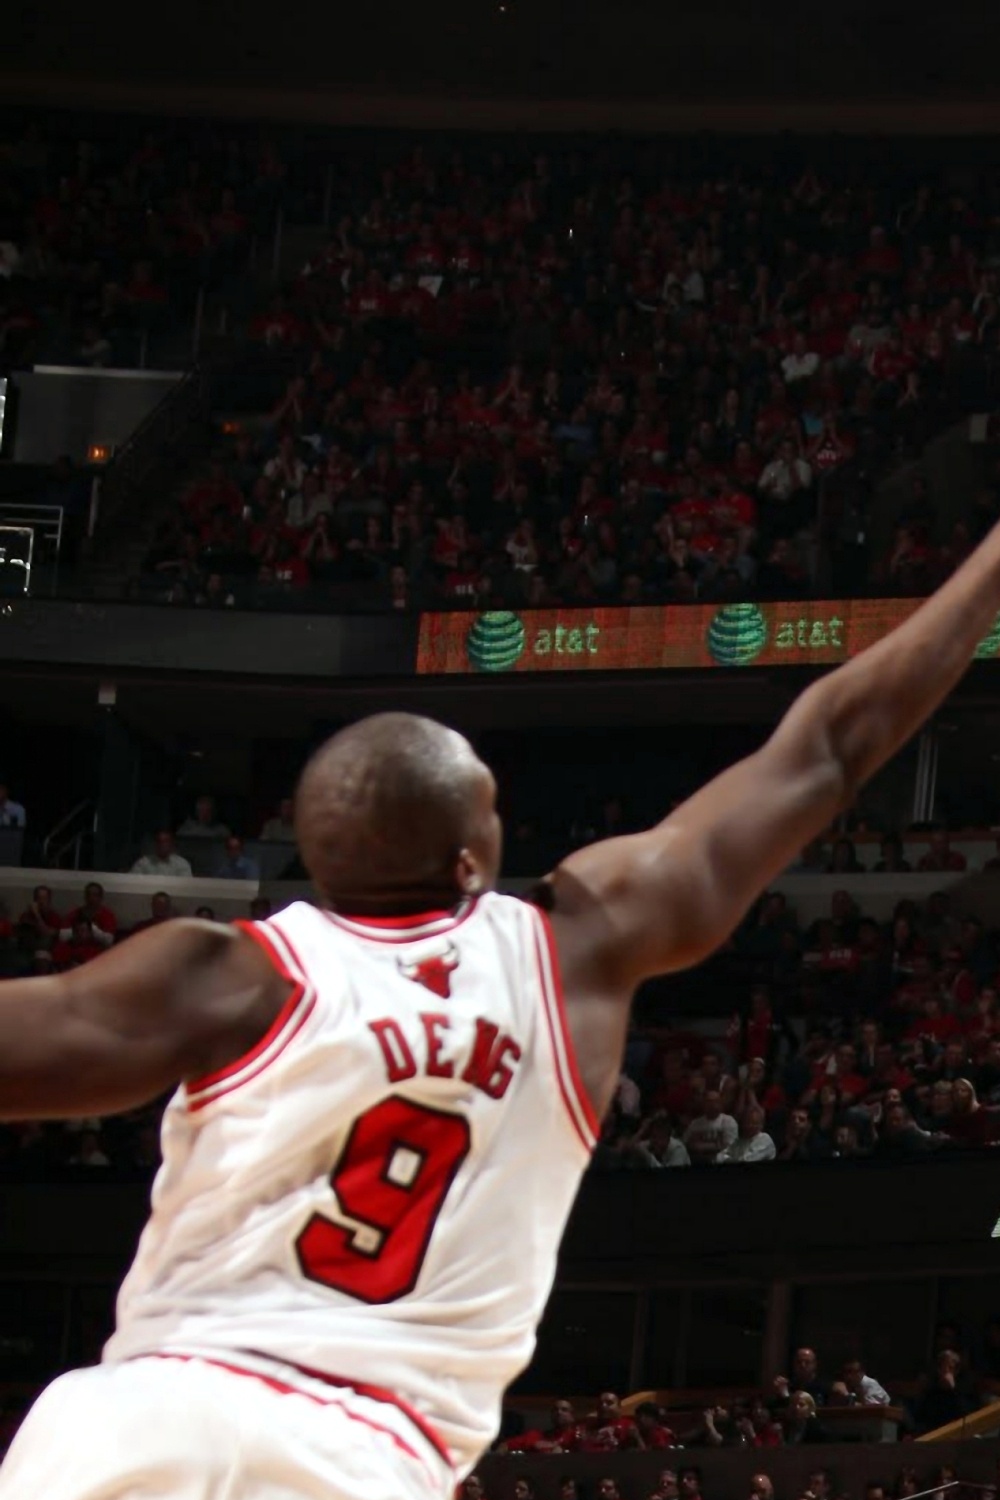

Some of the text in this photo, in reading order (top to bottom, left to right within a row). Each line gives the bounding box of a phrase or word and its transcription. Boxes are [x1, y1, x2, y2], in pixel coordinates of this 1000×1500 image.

[534, 623, 600, 655] at&t
[775, 616, 844, 648] at&t
[367, 1010, 522, 1100] DENG
[294, 1093, 472, 1306] 9
